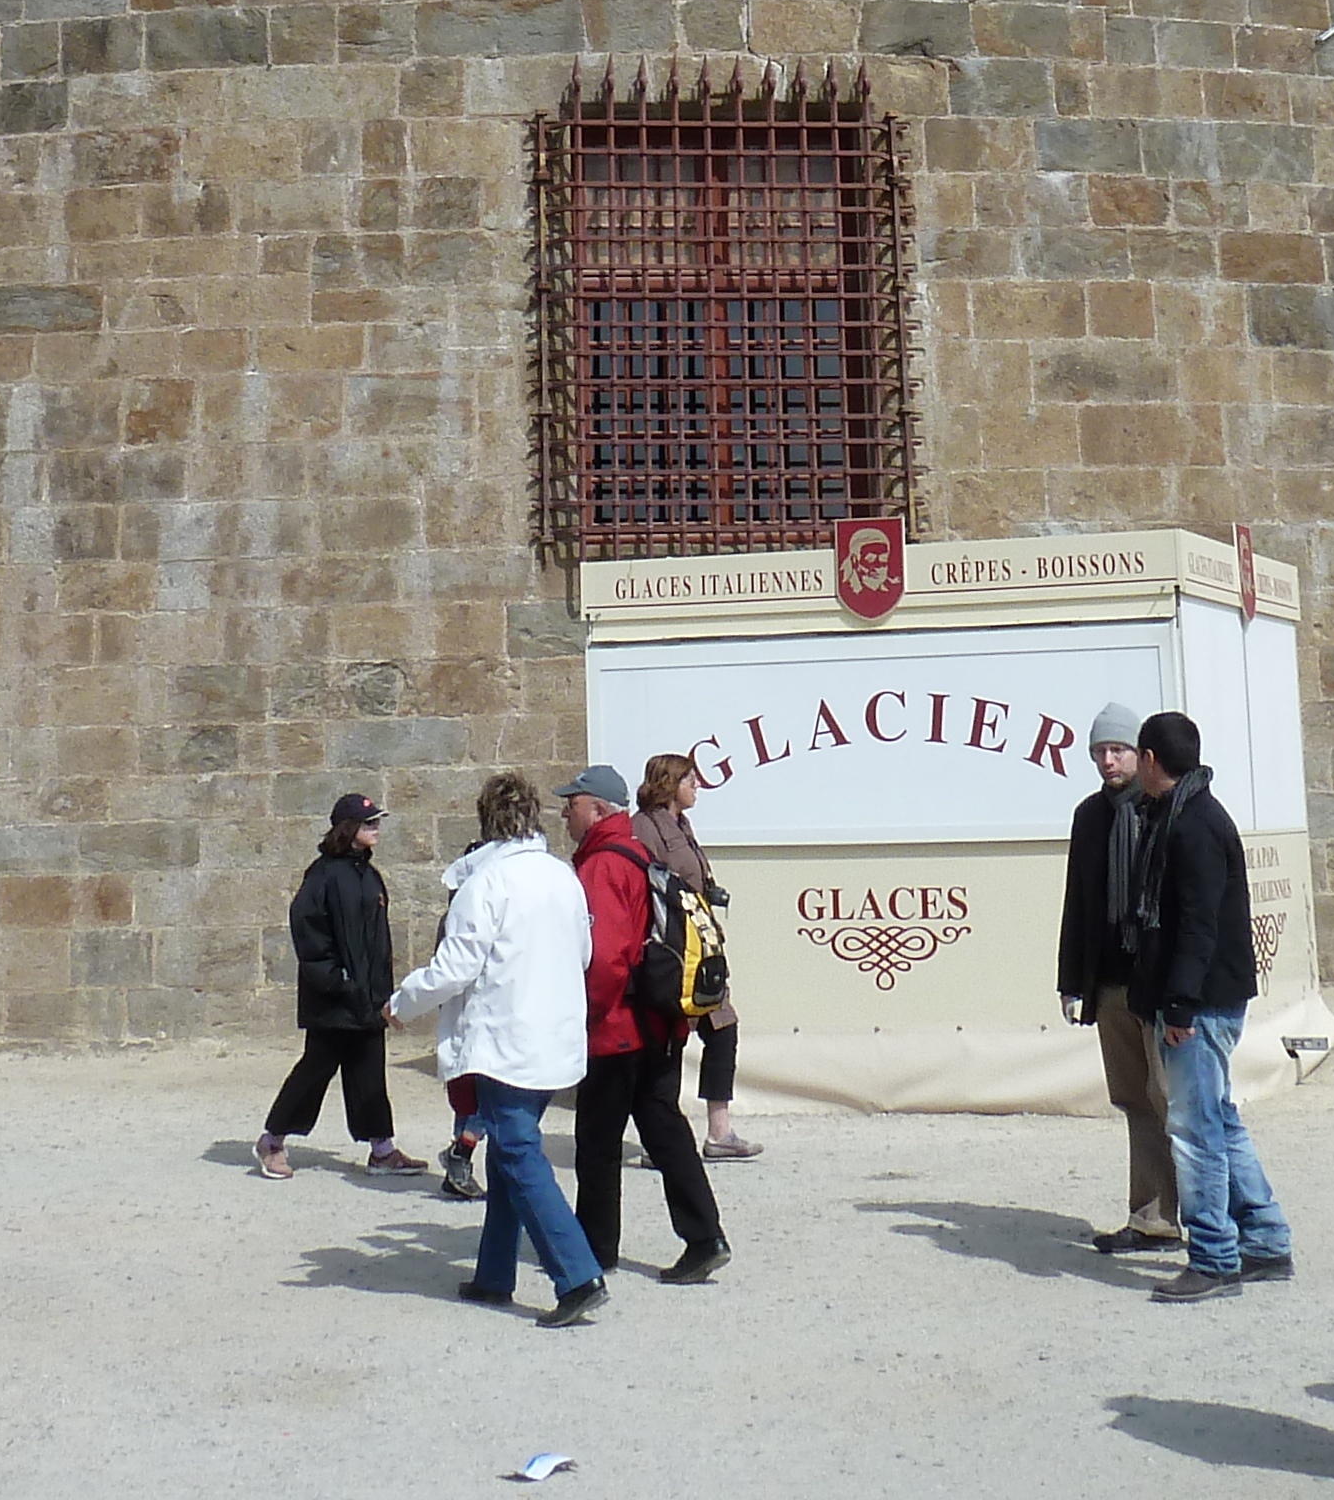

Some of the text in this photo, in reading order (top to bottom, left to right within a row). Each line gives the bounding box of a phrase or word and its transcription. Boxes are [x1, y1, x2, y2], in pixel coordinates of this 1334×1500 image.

[615, 569, 823, 600] GLACES ITALIENNES
[931, 555, 1012, 585] CRÊPES
[1036, 551, 1145, 579] BOISSONS
[688, 690, 1076, 790] GLACIER
[797, 886, 968, 921] GLACES
